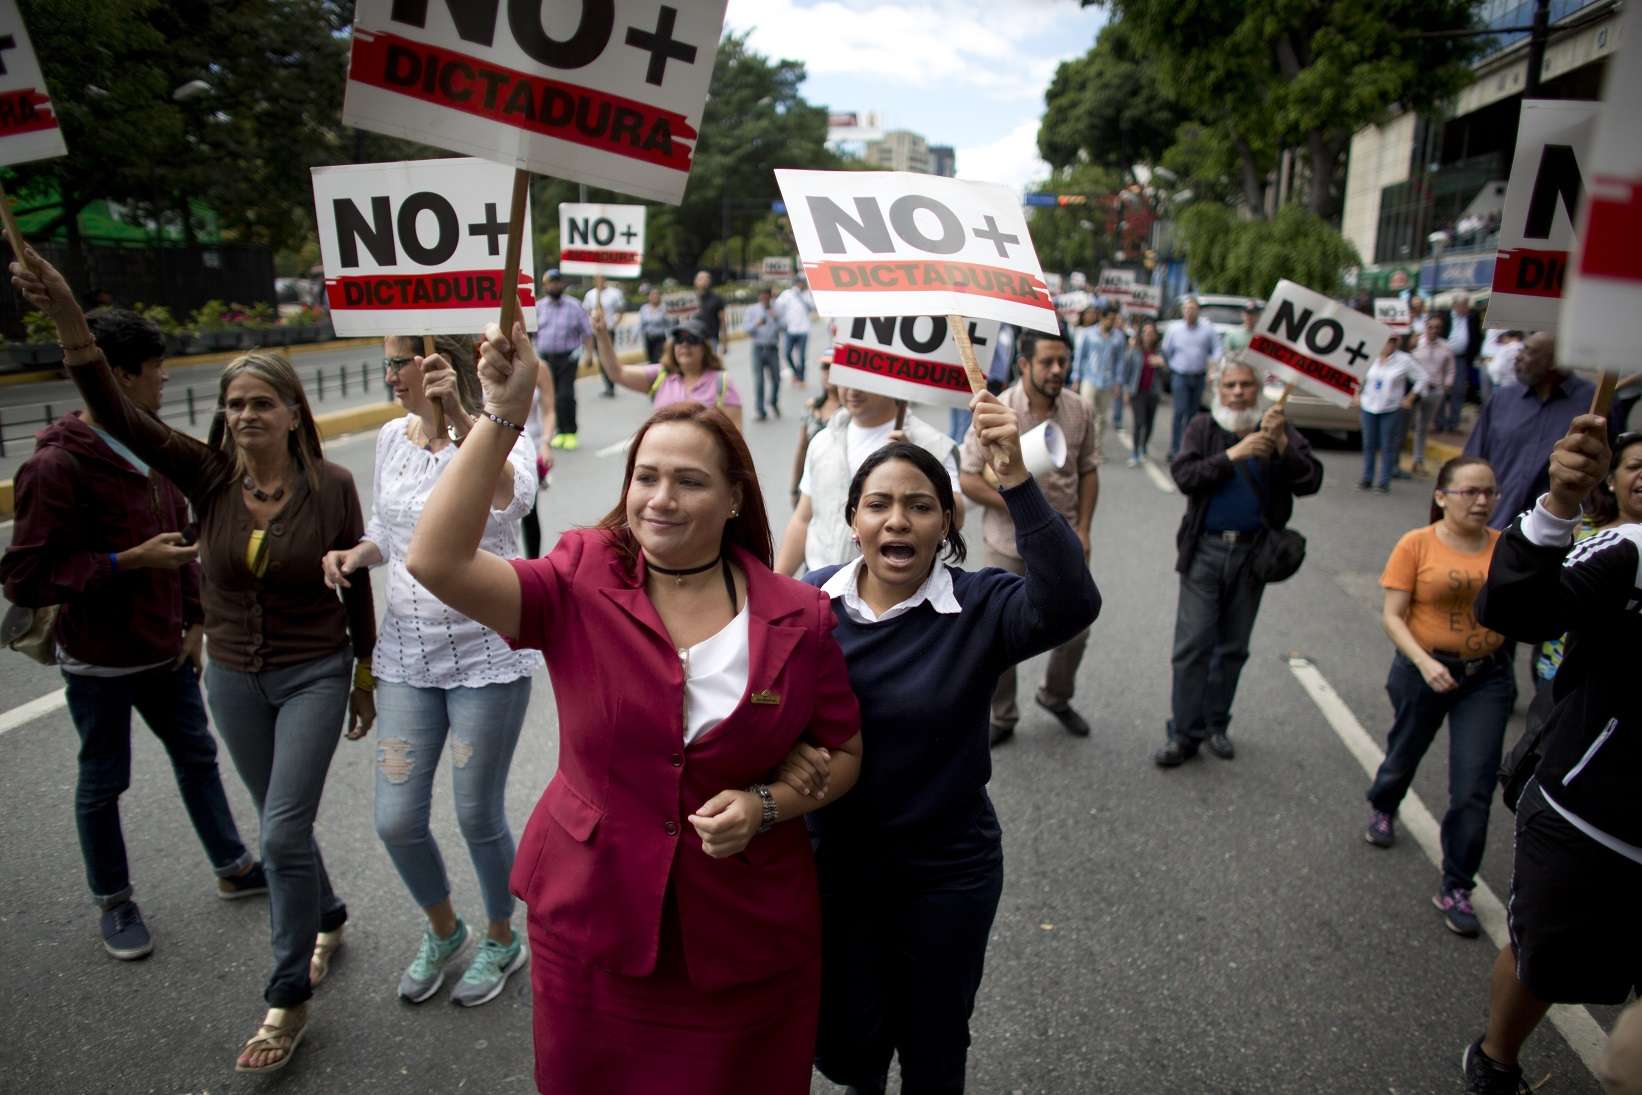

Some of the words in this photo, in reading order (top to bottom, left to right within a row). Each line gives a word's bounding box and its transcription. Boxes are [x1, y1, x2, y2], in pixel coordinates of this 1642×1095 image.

[384, 44, 674, 156] DICTADURA
[343, 275, 503, 307] DICTADUR
[829, 263, 1039, 300] DICTADURA
